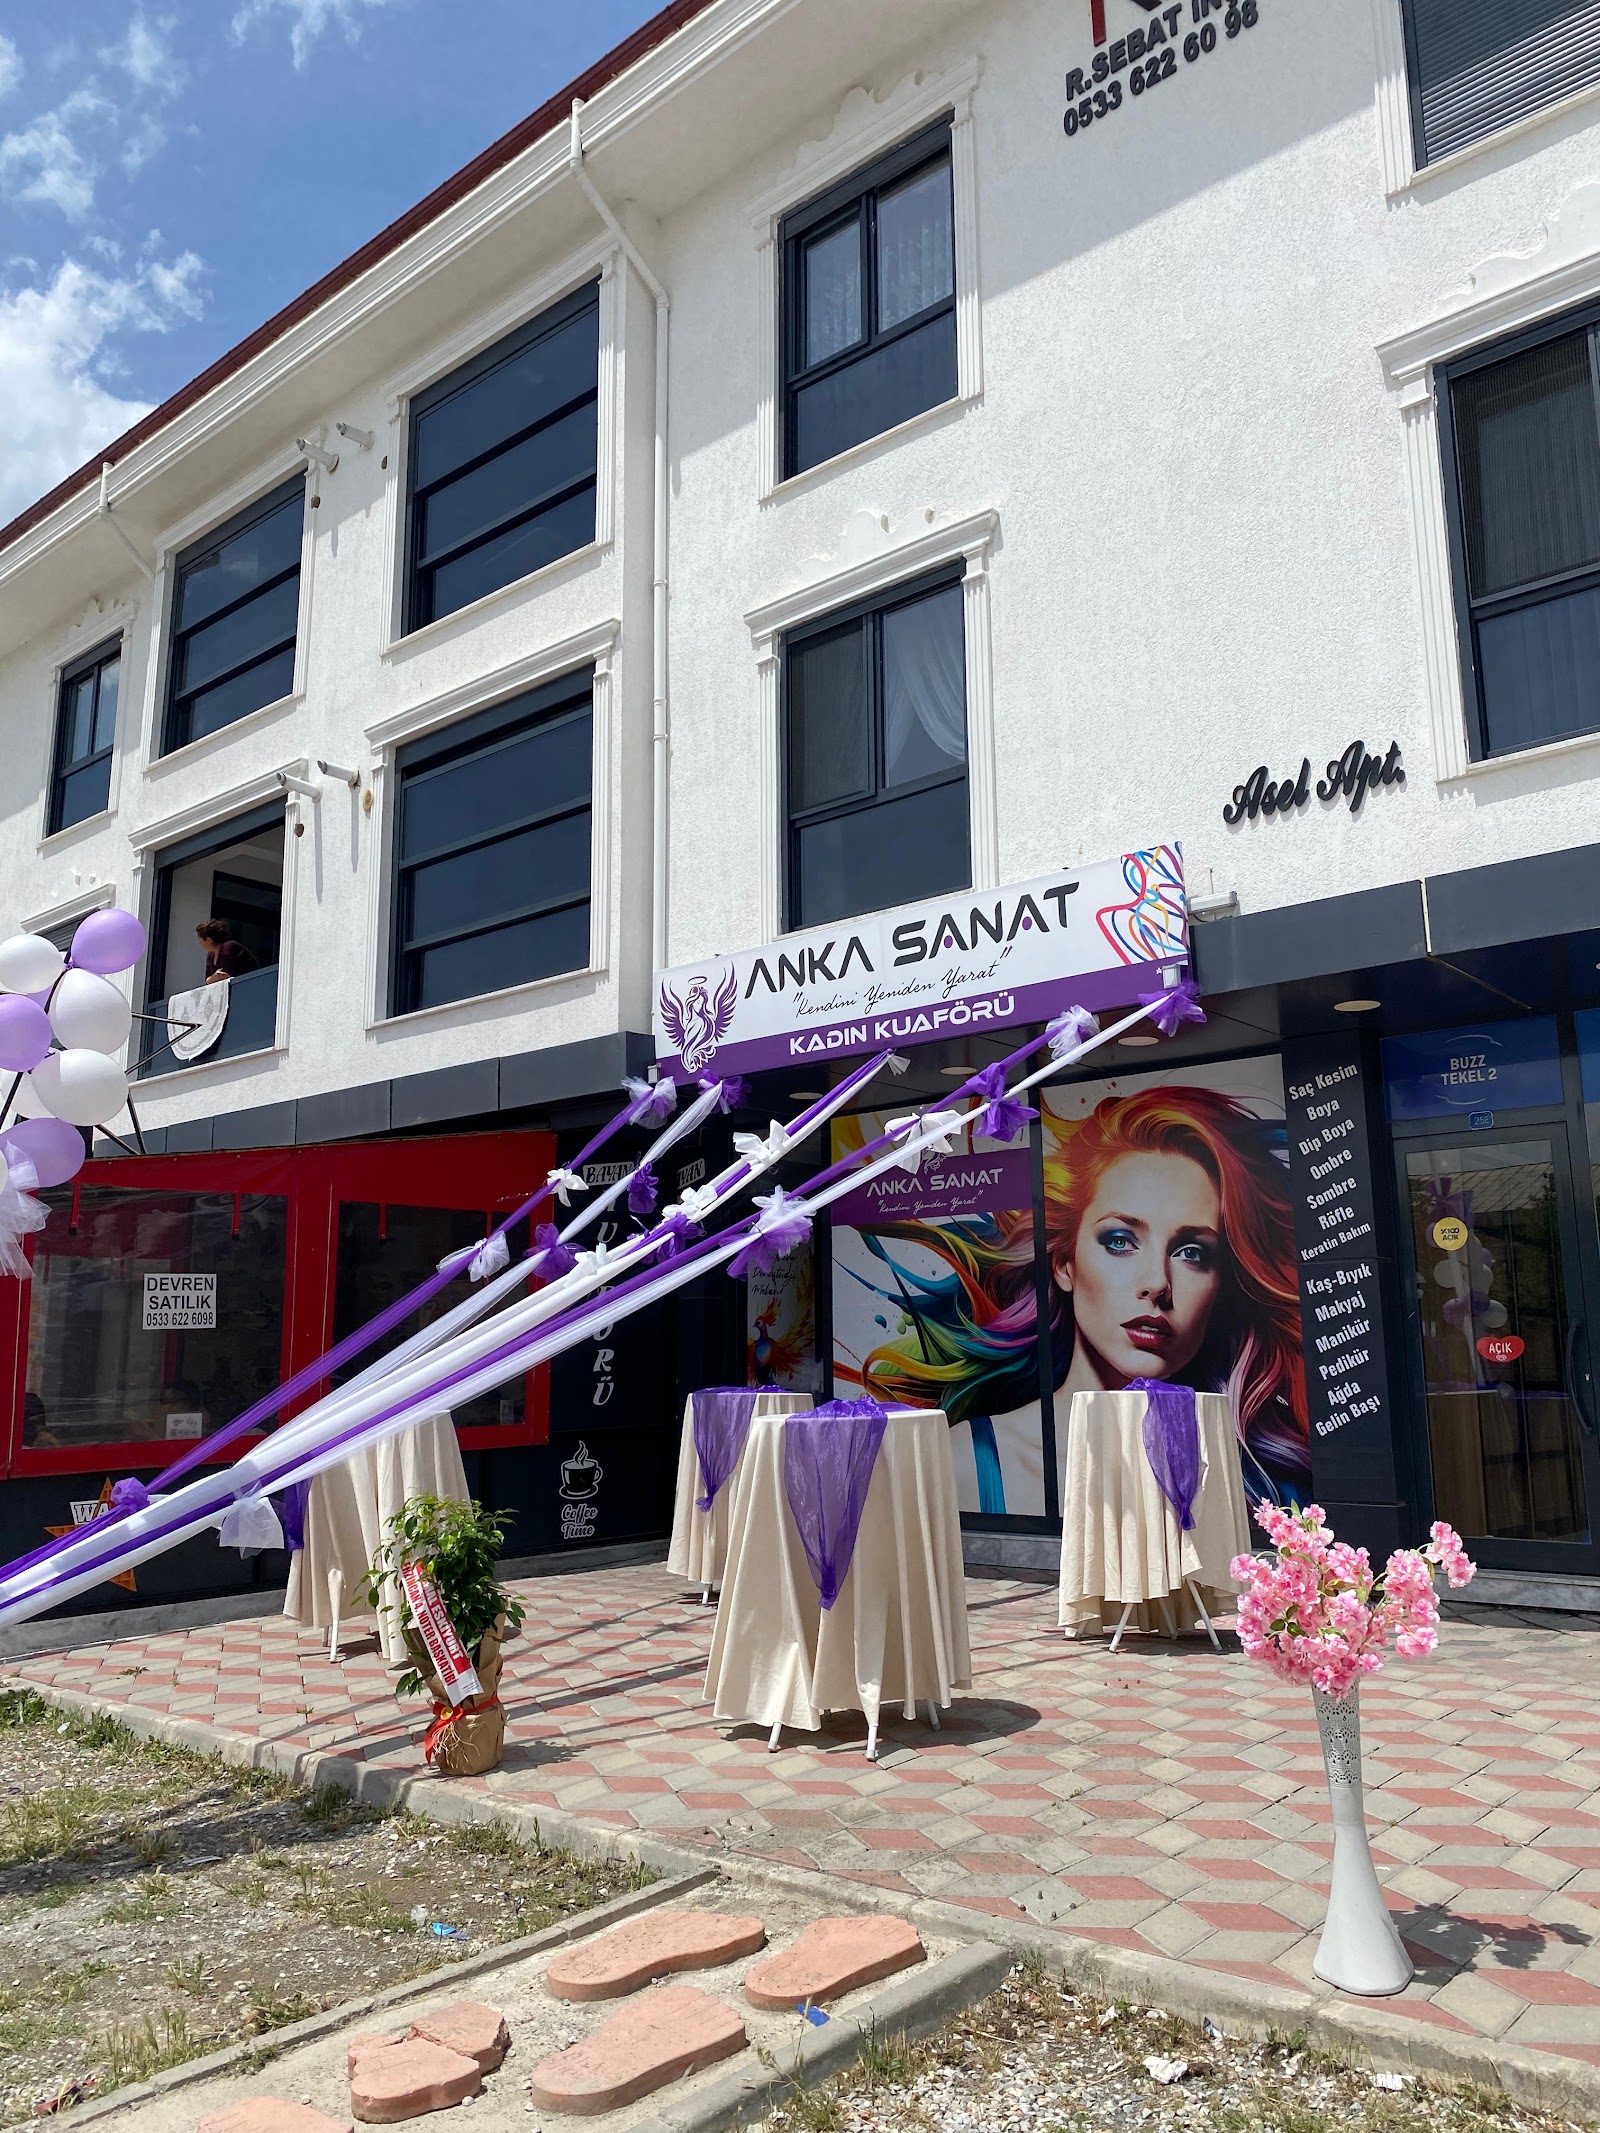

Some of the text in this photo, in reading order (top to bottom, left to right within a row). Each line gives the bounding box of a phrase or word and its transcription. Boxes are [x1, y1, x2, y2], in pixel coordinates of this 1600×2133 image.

[1063, 80, 1123, 136] 0533
[1129, 47, 1178, 96] 622
[1183, 22, 1217, 63] 60
[1224, 0, 1259, 39] 98
[1065, 2, 1183, 102] R.SEBAT
[1223, 740, 1406, 825] Asel Apt.
[744, 881, 1080, 1000] ANKA SANAT
[863, 977, 936, 1014] Yeniden
[789, 991, 1016, 1056] KADIN KUAFÖRÜ
[1440, 1067, 1498, 1086] TEKEL 2
[1449, 1054, 1487, 1071] BUZZ
[1288, 1063, 1359, 1100] Saç Kesim
[1306, 1099, 1341, 1122] Boya
[1298, 1118, 1356, 1156] Dip Boya
[1309, 1149, 1353, 1180] Ombre
[866, 1167, 1004, 1199] ANKA SANAT
[1306, 1176, 1357, 1210] Sombre
[912, 1200, 948, 1216] Yeniden
[1317, 1206, 1355, 1230] Röfle
[1300, 1222, 1372, 1261] Keratin Bakım
[1442, 1234, 1460, 1242] AÇIK
[146, 1277, 214, 1292] DEVREN
[1305, 1263, 1373, 1295] Kaş-Bıyık
[148, 1295, 212, 1310] SATILIK
[1314, 1290, 1366, 1323] Makyaj
[146, 1311, 214, 1327] 0533 622 6098
[1315, 1318, 1371, 1354] Manikür
[1488, 1342, 1513, 1355] AÇIK
[1318, 1348, 1370, 1381] Pedikür
[1326, 1381, 1361, 1406] Ağda
[1315, 1395, 1382, 1437] Gelin Başı
[561, 1503, 599, 1525] Coffee
[560, 1521, 596, 1540] Time
[413, 1601, 424, 1613] 4.
[416, 1609, 437, 1641] NOTER
[431, 1606, 464, 1661] ESKİYURT
[428, 1638, 460, 1687] BAŞKATİBİ
